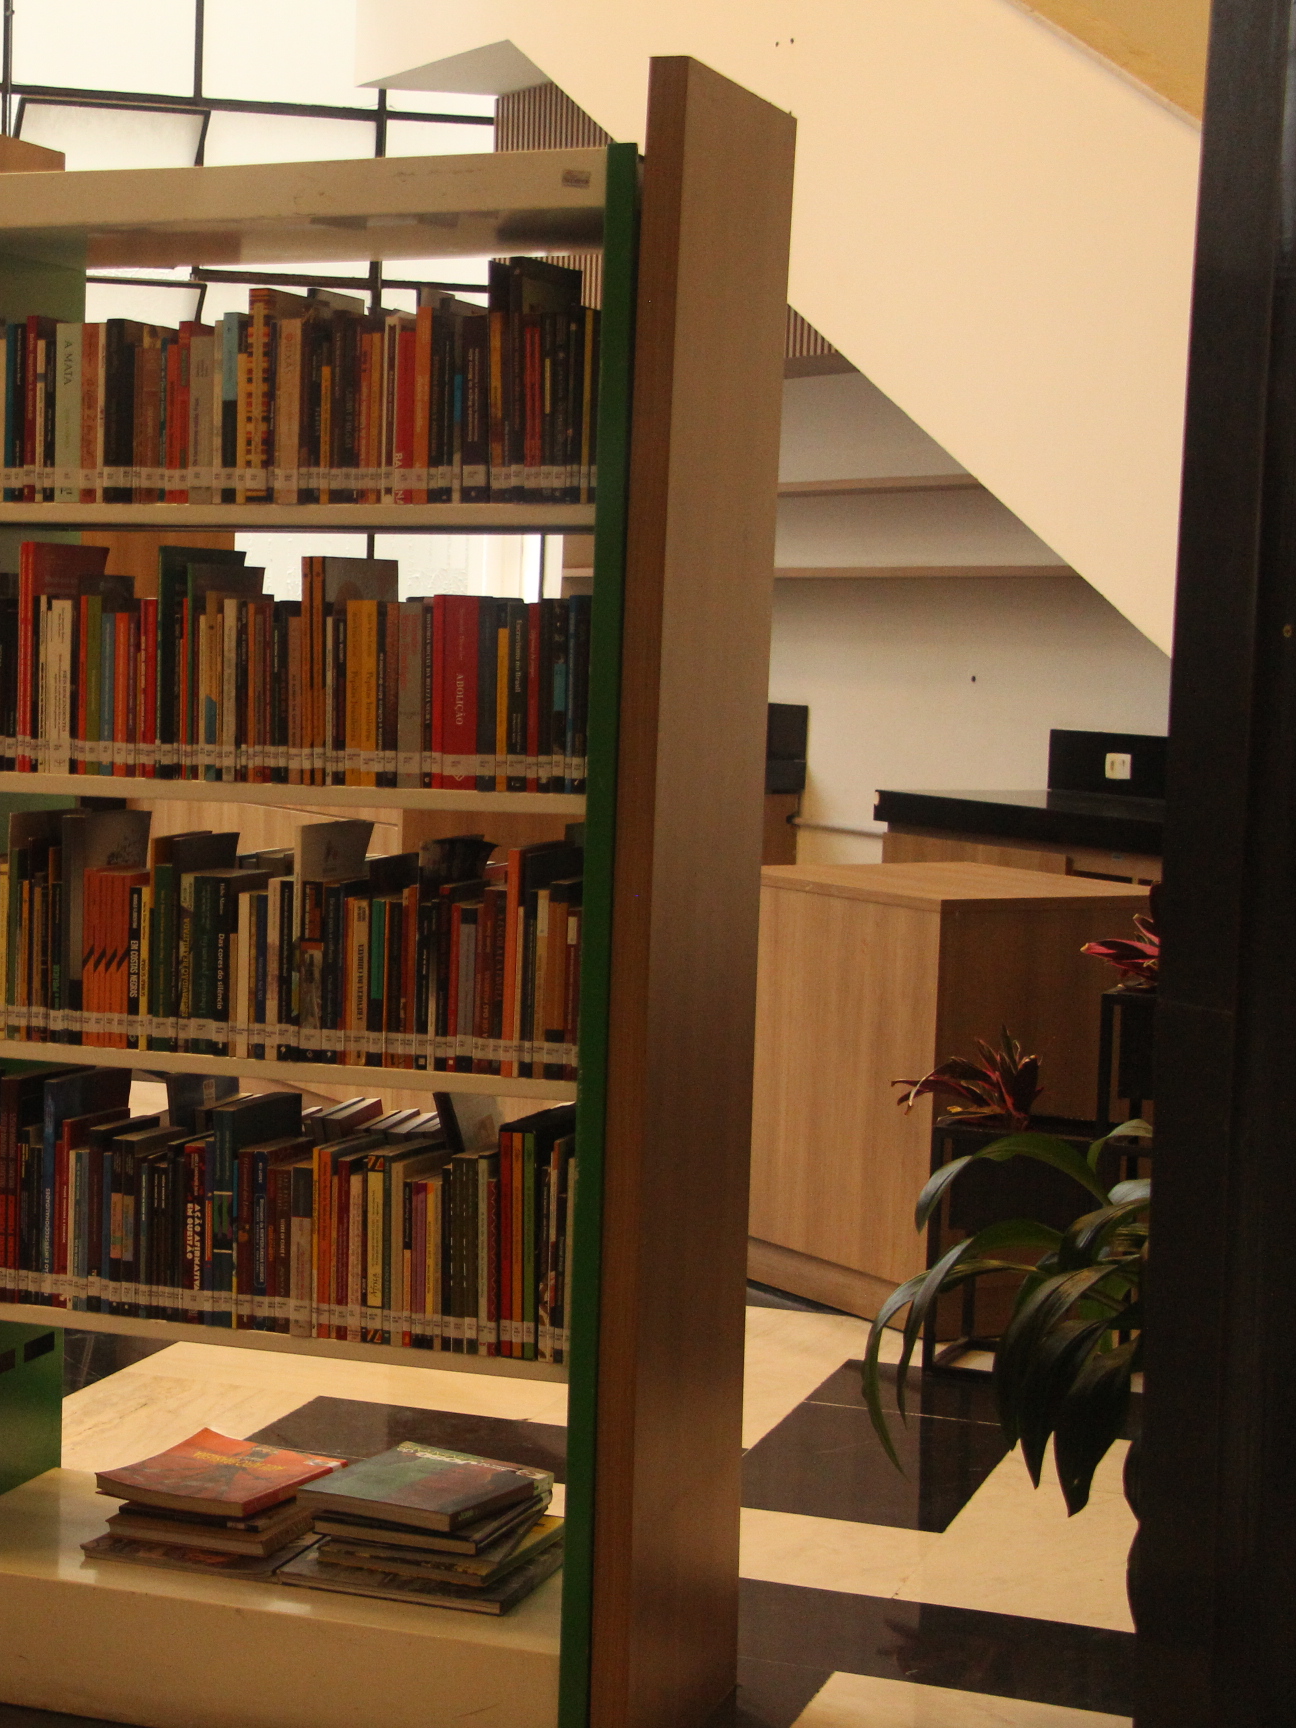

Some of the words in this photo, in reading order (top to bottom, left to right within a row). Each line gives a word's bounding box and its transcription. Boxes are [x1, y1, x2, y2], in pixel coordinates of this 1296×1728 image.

[64, 340, 73, 349] A
[64, 352, 73, 386] MATA
[455, 674, 466, 725] ABOLIÇÃO
[130, 940, 139, 950] EM
[130, 951, 139, 973] COSTAS
[129, 974, 138, 998] NEGRAS
[217, 970, 224, 980] do
[186, 1203, 193, 1216] EM
[194, 1203, 202, 1232] AÇÃO
[186, 1217, 194, 1260] QUESTÃO
[193, 1234, 201, 1290] AFIRMATIVA
